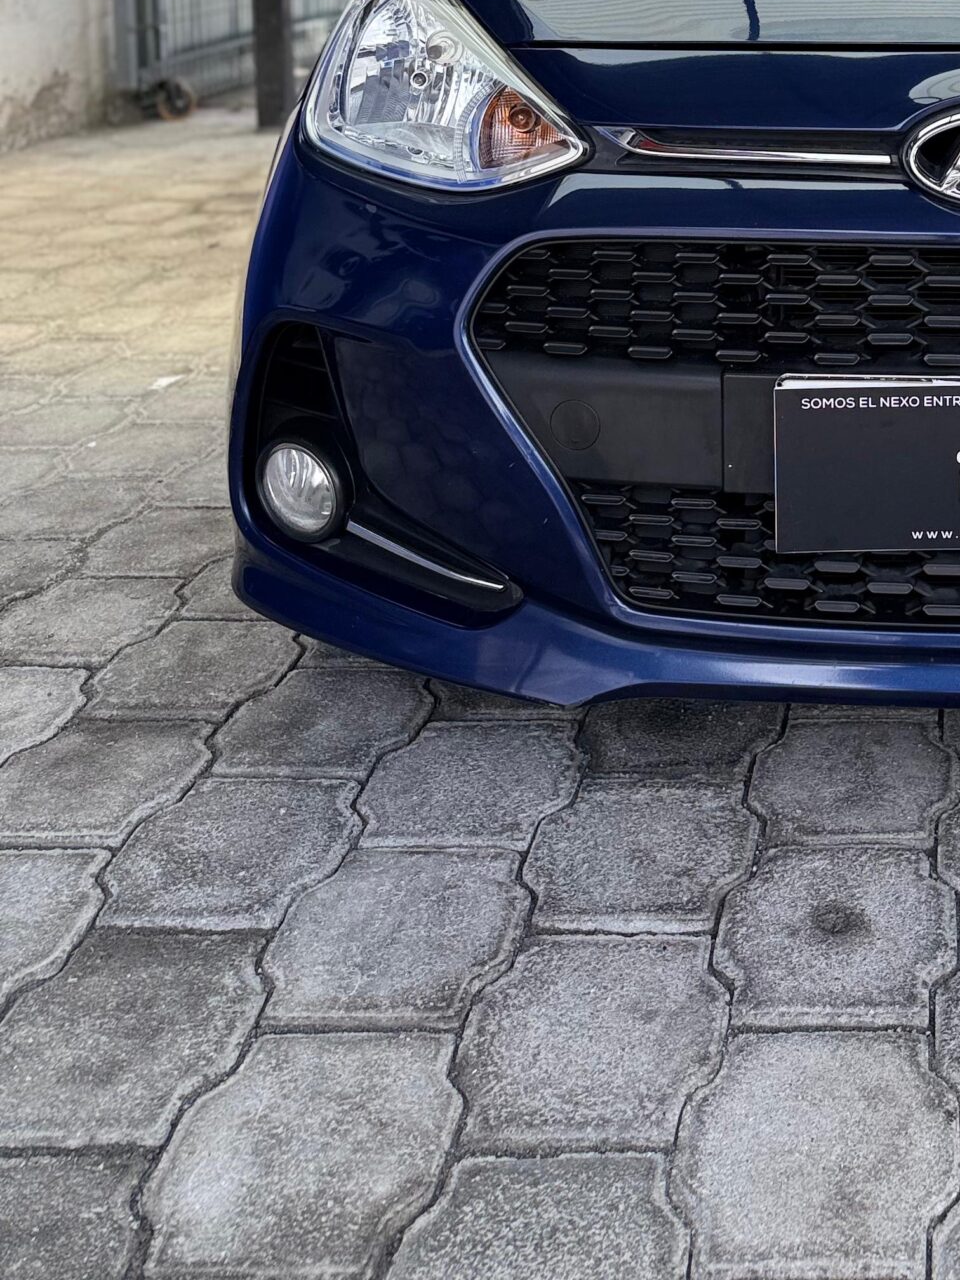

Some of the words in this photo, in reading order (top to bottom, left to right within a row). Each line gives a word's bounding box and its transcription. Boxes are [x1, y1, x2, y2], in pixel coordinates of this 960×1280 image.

[801, 397, 855, 410] SOMOS
[859, 397, 877, 408] EL
[880, 396, 920, 408] NEXO
